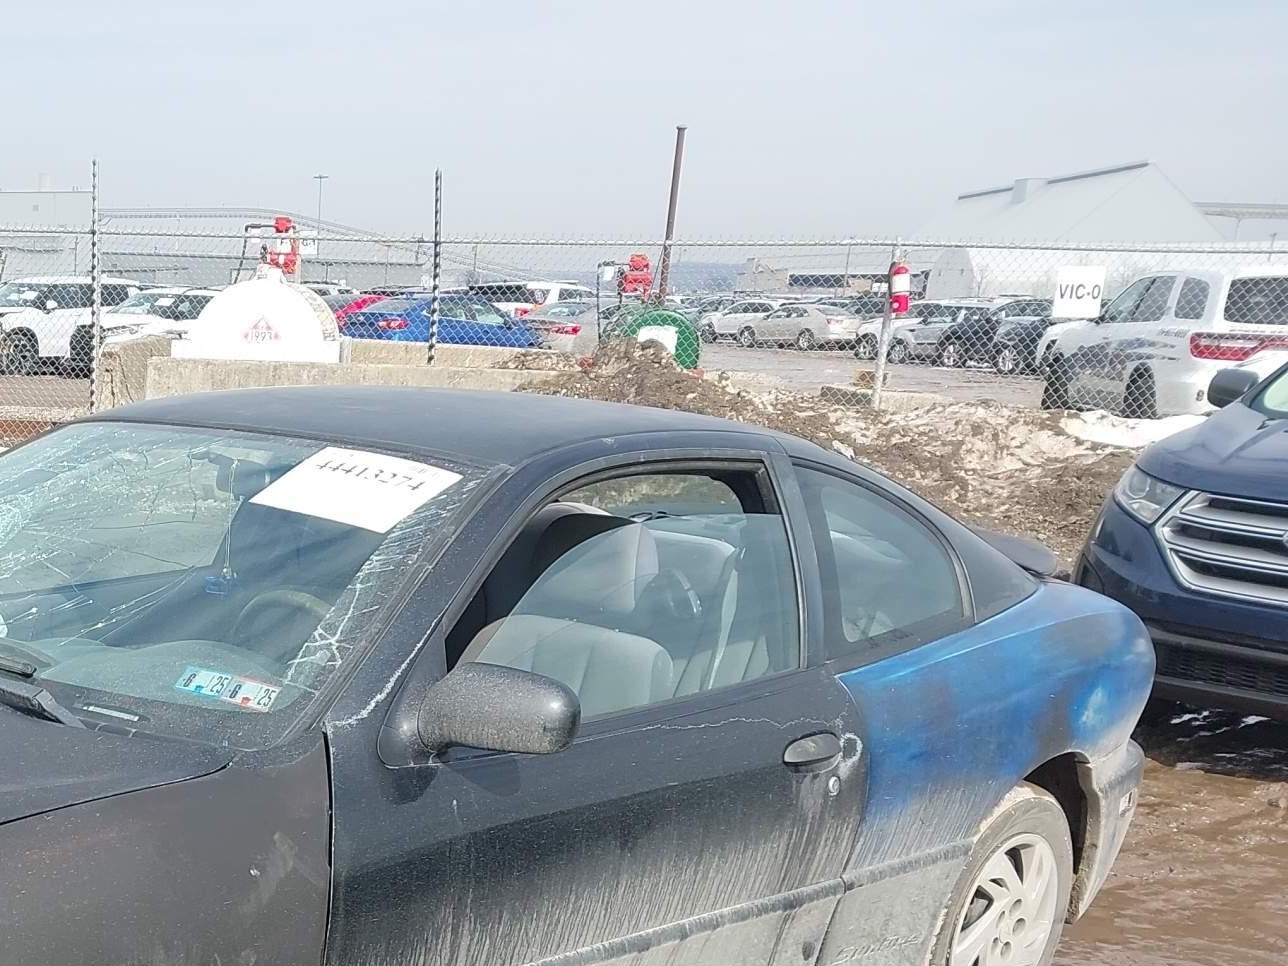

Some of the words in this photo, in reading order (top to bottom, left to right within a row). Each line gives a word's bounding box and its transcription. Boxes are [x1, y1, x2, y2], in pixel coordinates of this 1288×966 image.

[316, 460, 426, 491] 44413274
[210, 675, 229, 696] 25
[257, 688, 276, 708] 25
